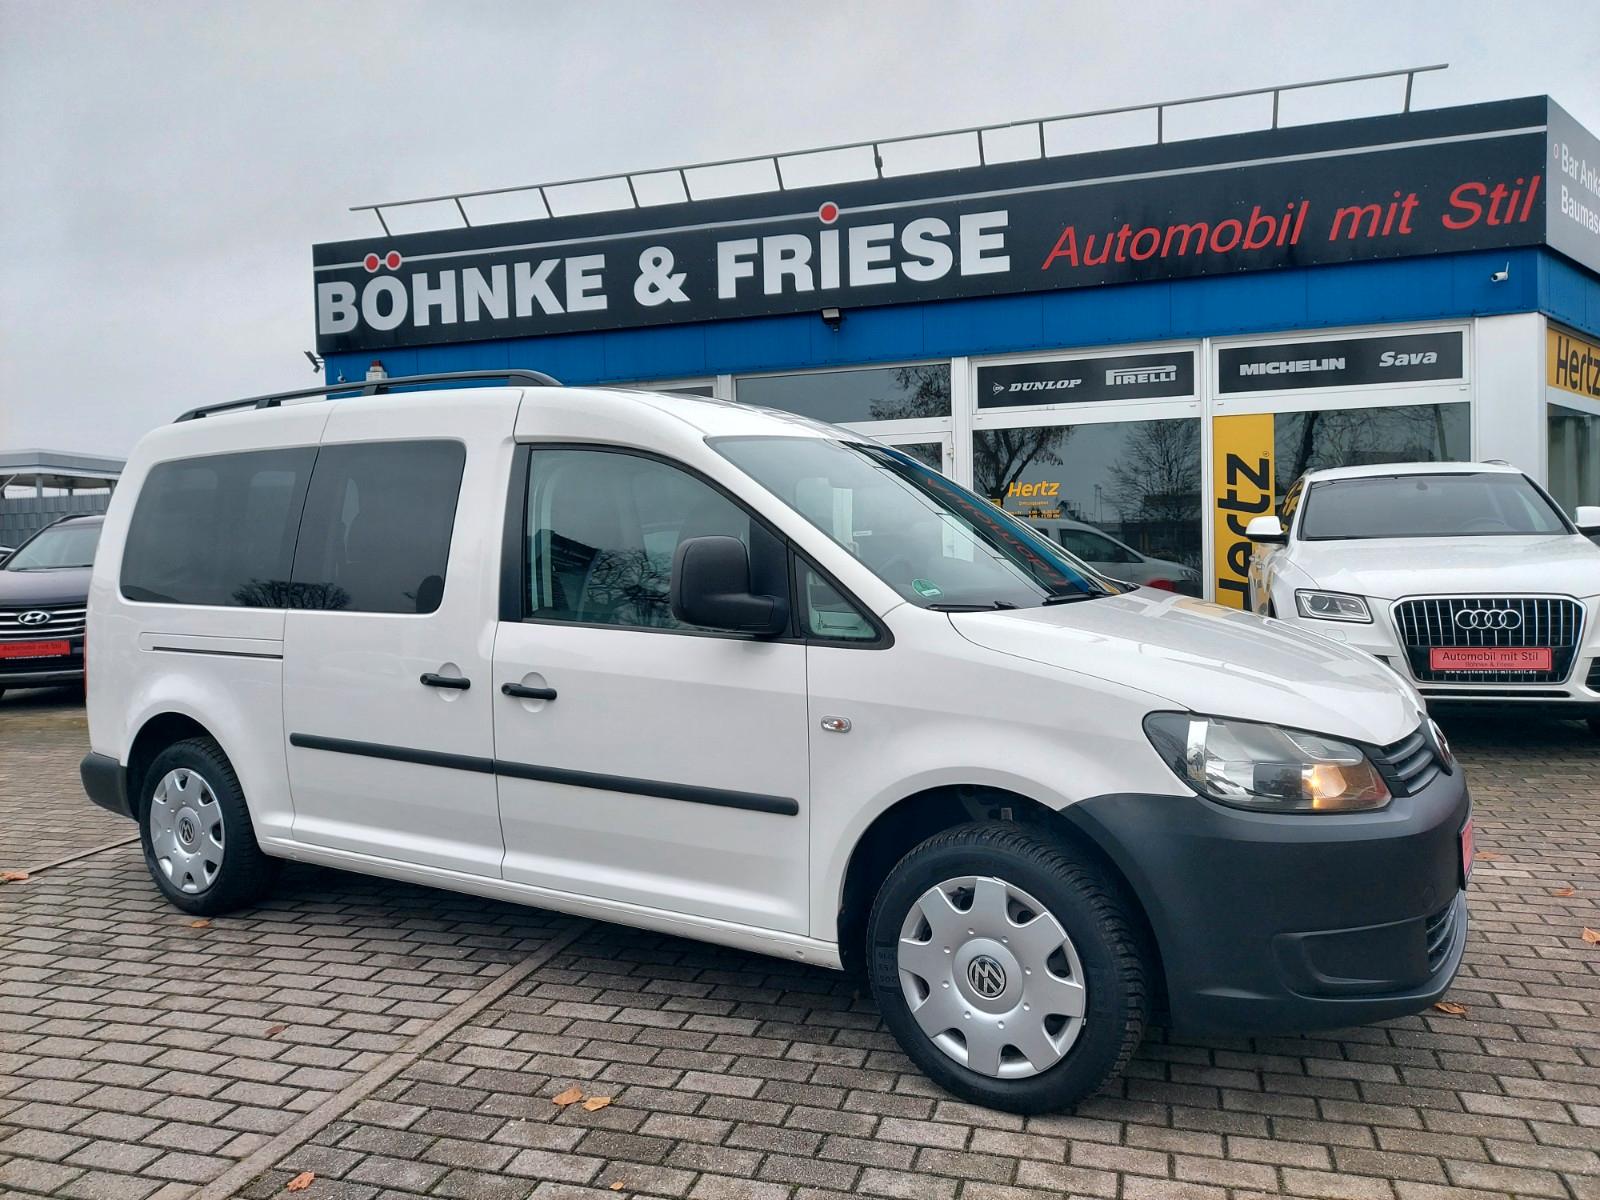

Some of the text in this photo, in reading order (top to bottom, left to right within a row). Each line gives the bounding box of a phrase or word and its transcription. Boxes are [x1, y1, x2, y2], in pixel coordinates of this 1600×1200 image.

[1561, 143, 1579, 180] Bar
[1561, 185, 1600, 235] Baumas
[317, 175, 1541, 335] BÖHNKE & FRIESE Automobil mit Stil
[1239, 357, 1346, 376] MICHELIN
[1379, 351, 1438, 367] Sava
[1556, 335, 1600, 395] Hertz
[1008, 379, 1082, 392] DUNLOP
[1105, 365, 1177, 386] PIRELLI
[1008, 480, 1060, 497] Hertz
[1442, 651, 1539, 661] Automobil mit Stil
